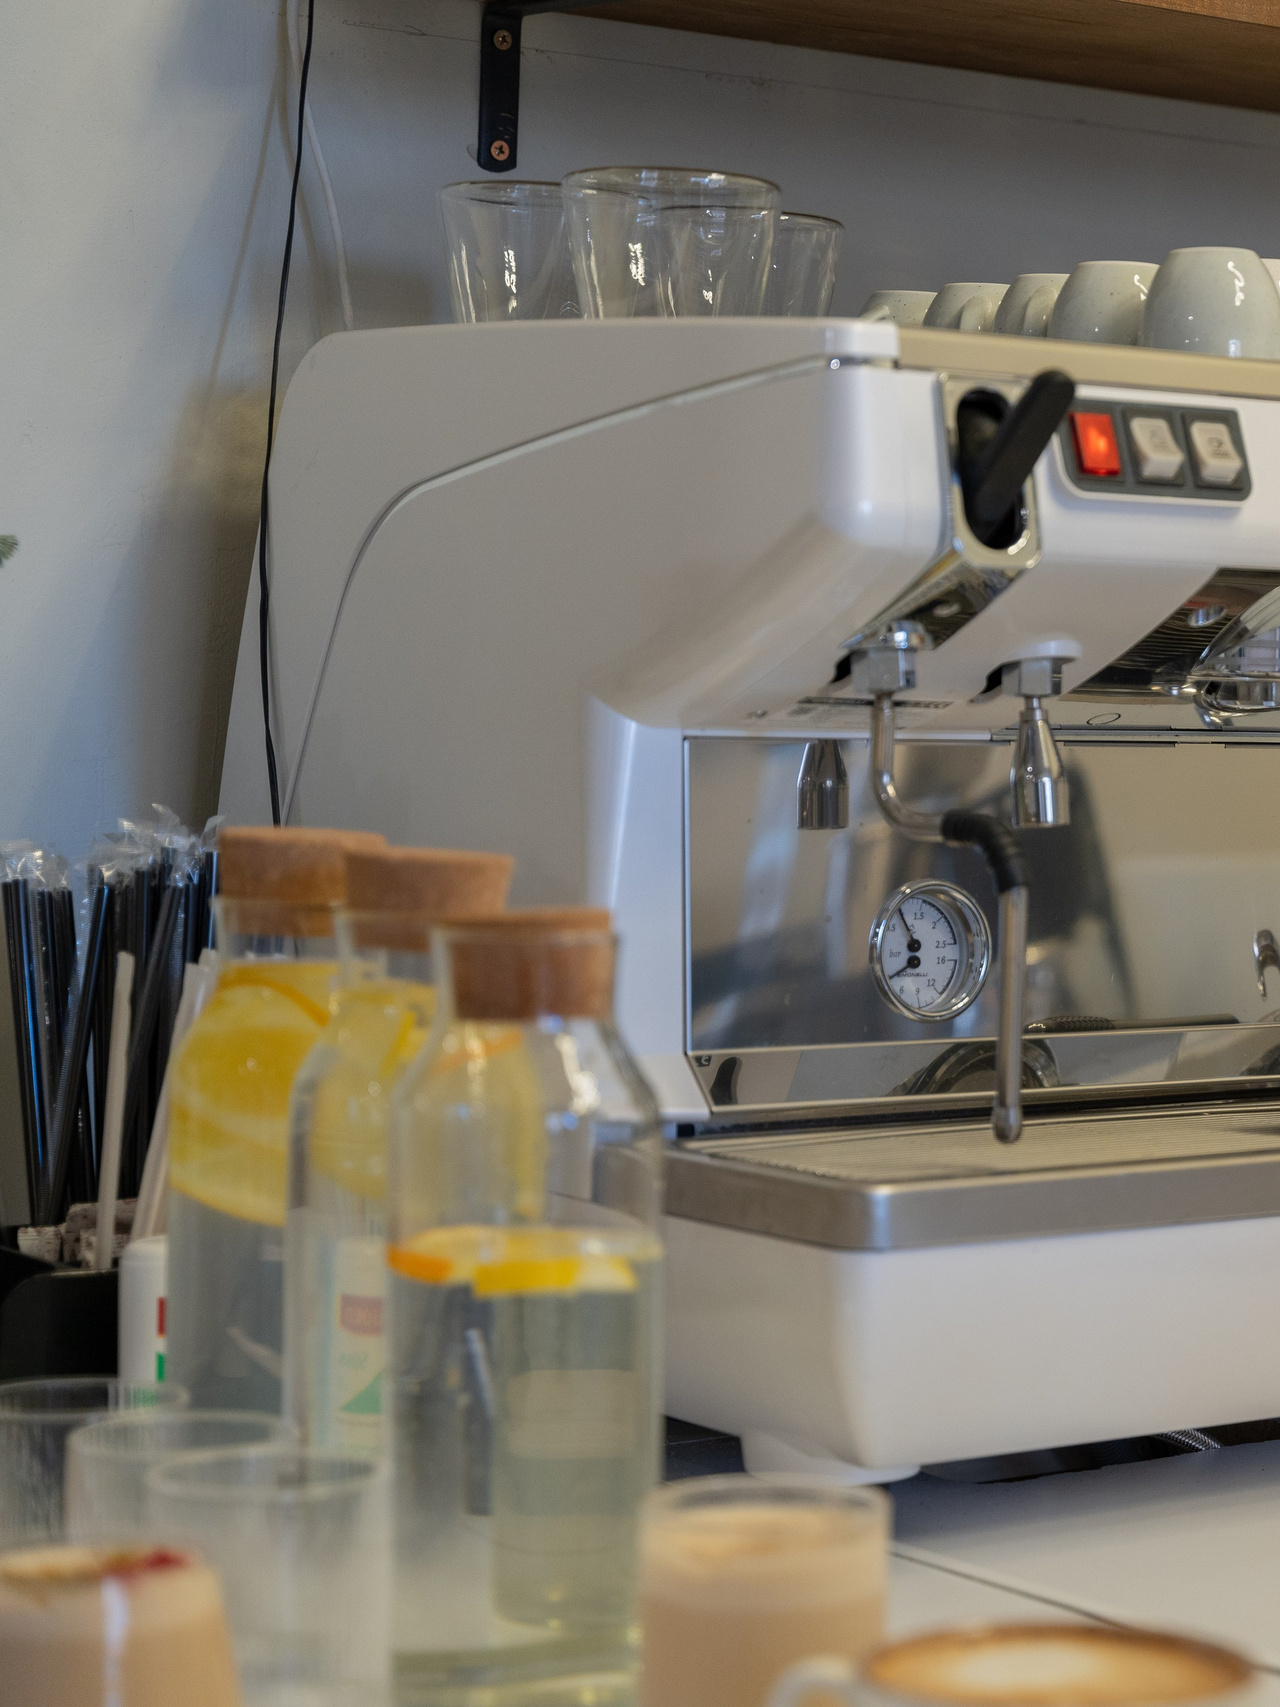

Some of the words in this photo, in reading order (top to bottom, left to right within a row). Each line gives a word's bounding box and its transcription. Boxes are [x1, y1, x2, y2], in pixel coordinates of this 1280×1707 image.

[913, 912, 924, 920] 1.5
[932, 922, 937, 930] 2
[935, 941, 947, 949] 2.5
[889, 949, 901, 958] bar
[936, 957, 946, 965] 16
[927, 979, 935, 987] 12
